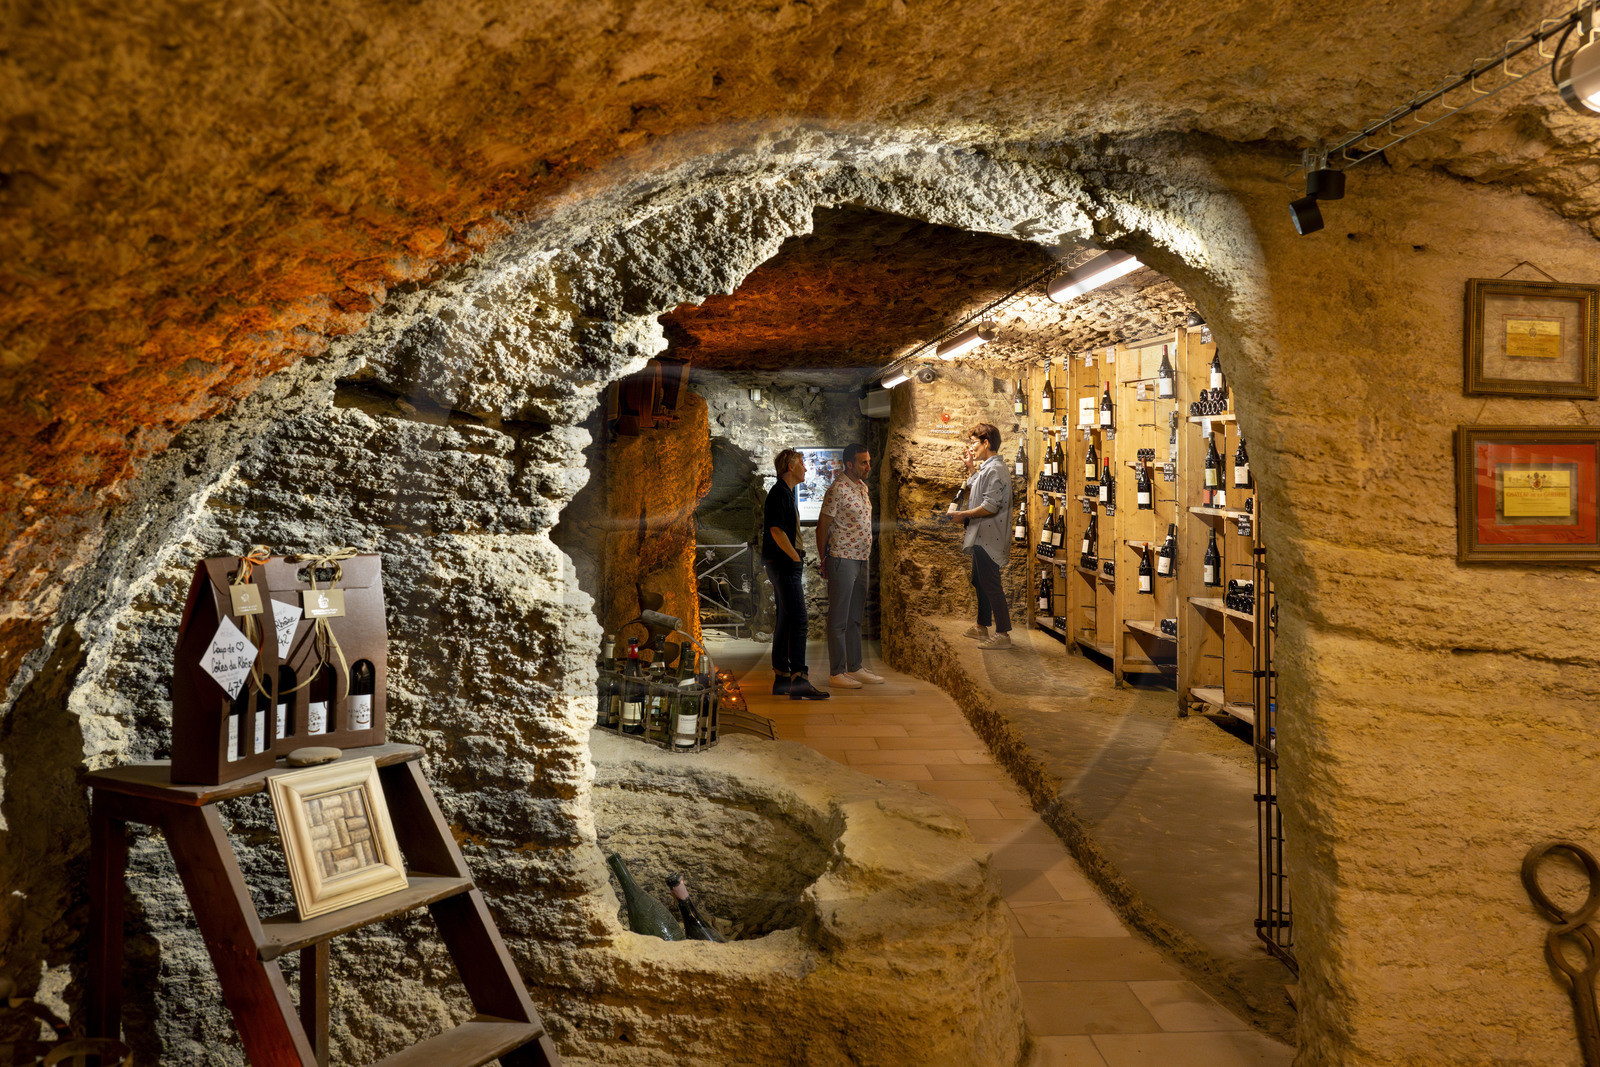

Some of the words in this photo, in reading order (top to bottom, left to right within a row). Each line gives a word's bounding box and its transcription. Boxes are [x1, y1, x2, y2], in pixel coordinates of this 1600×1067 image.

[212, 641, 226, 659] Coup
[227, 644, 234, 653] de
[229, 660, 237, 670] du
